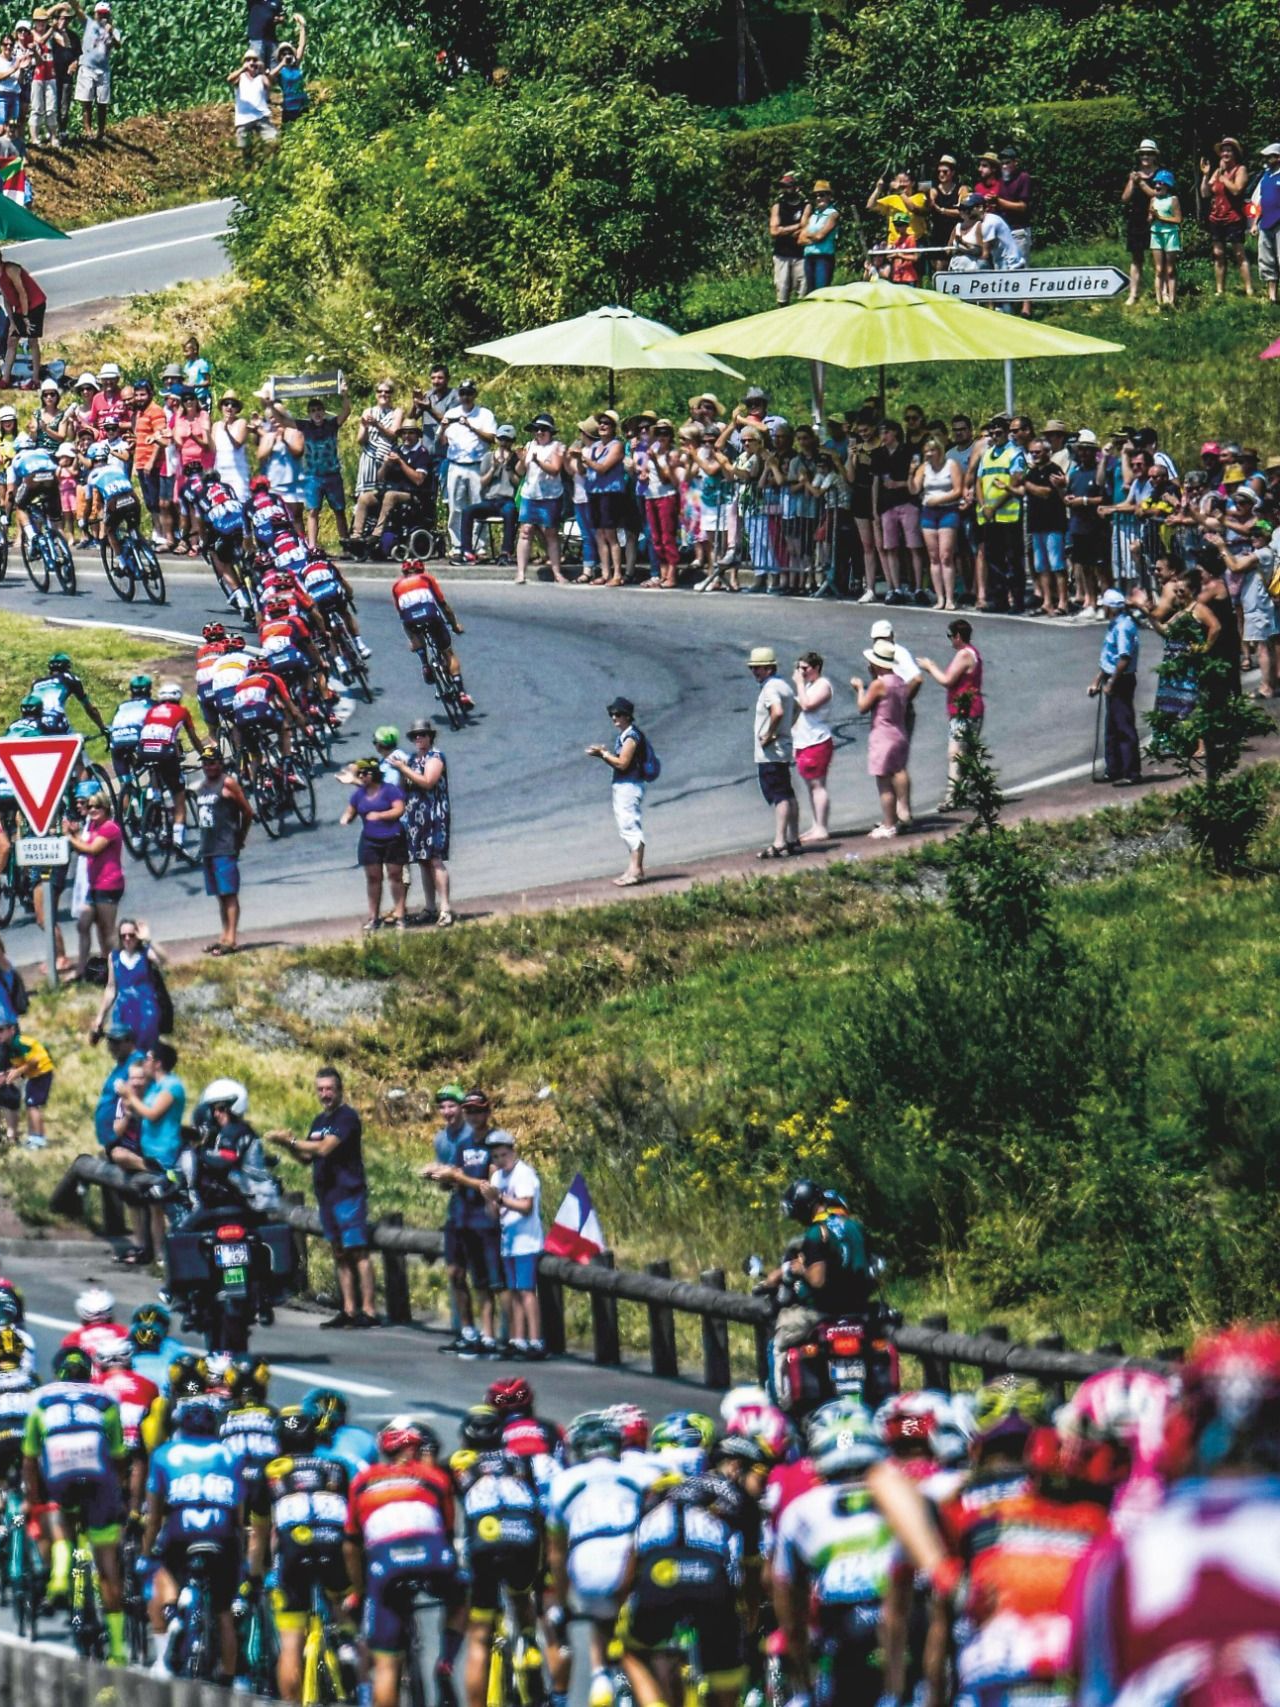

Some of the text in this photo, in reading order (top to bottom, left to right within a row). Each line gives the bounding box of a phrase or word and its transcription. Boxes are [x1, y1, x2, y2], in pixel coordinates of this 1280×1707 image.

[943, 275, 1109, 295] La Petite Fraudière
